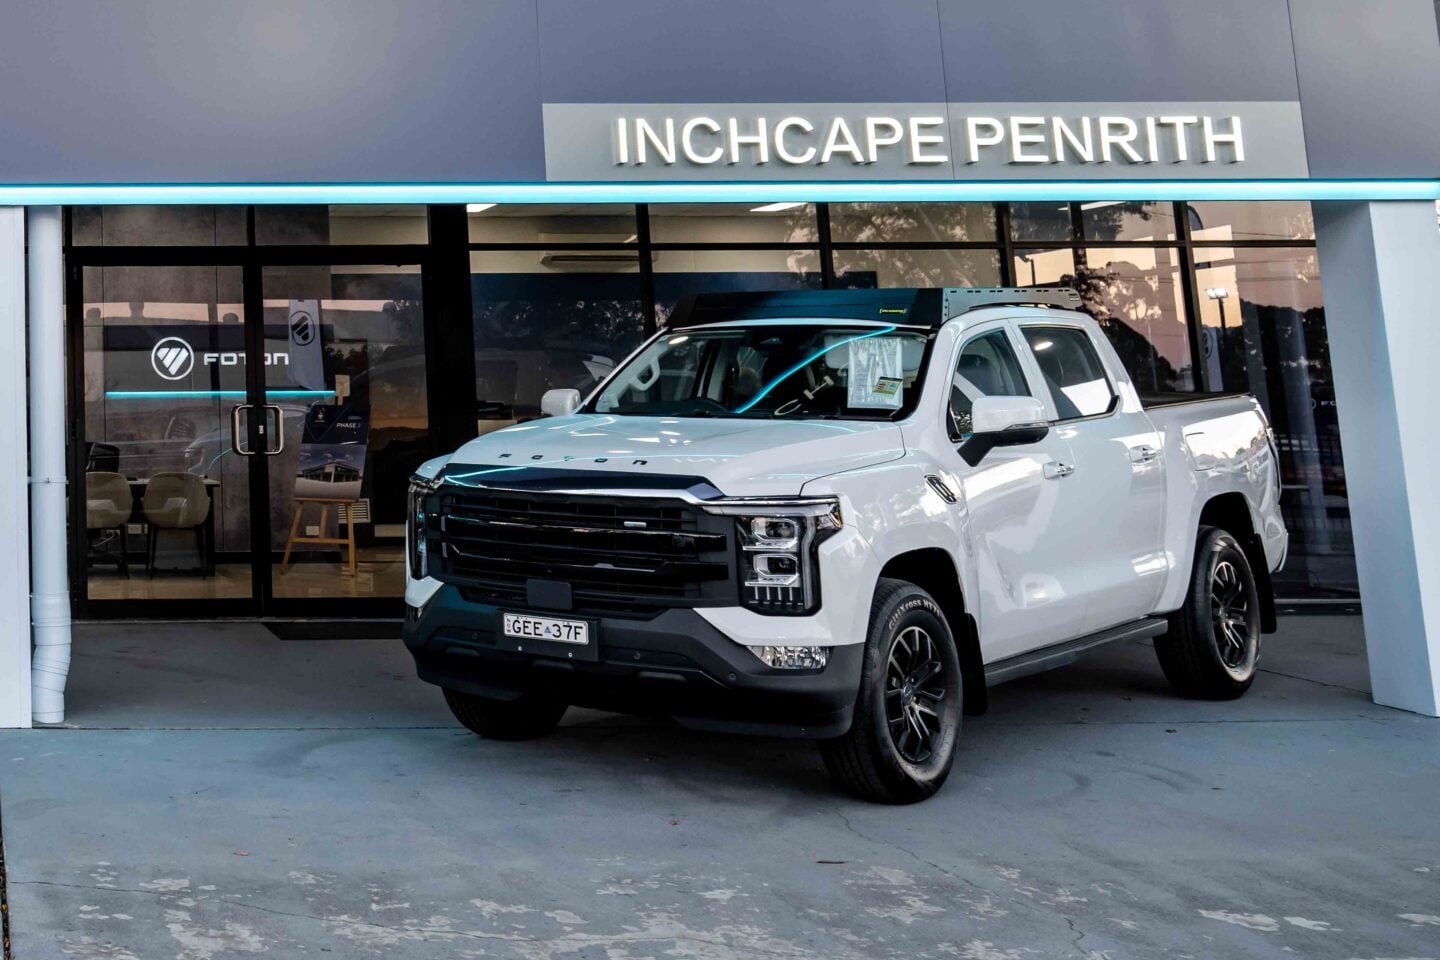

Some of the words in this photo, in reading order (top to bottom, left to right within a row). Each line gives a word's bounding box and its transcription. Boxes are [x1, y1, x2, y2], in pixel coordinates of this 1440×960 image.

[616, 116, 949, 164] INCHCAPE
[965, 115, 1246, 163] PENRITH
[512, 619, 543, 637] GEE
[552, 623, 584, 641] 37F
